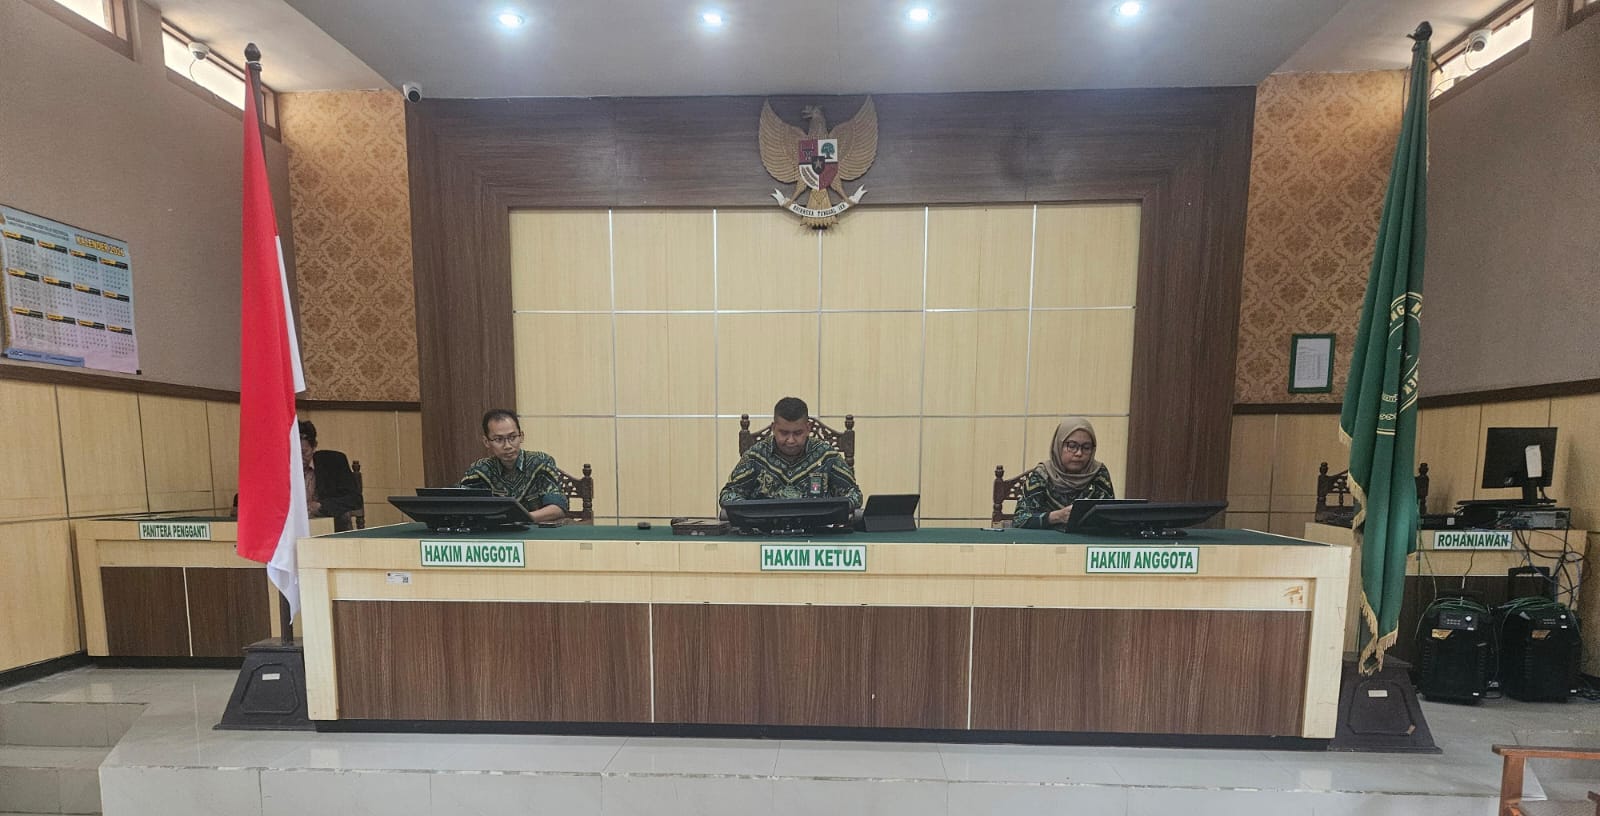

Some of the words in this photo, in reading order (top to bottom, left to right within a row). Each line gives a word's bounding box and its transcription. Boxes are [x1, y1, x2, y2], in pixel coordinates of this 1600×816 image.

[142, 524, 172, 538] PANITERA
[172, 525, 208, 538] PENGGANTI
[1437, 533, 1509, 547] ROHANIAWAN
[424, 544, 462, 562] HAKIM
[465, 545, 521, 563] ANGGOTA
[764, 549, 810, 567] HAKIM
[814, 549, 862, 567] KETUA
[1090, 551, 1131, 569] HAKIM
[1133, 551, 1194, 569] ANGGOTA
